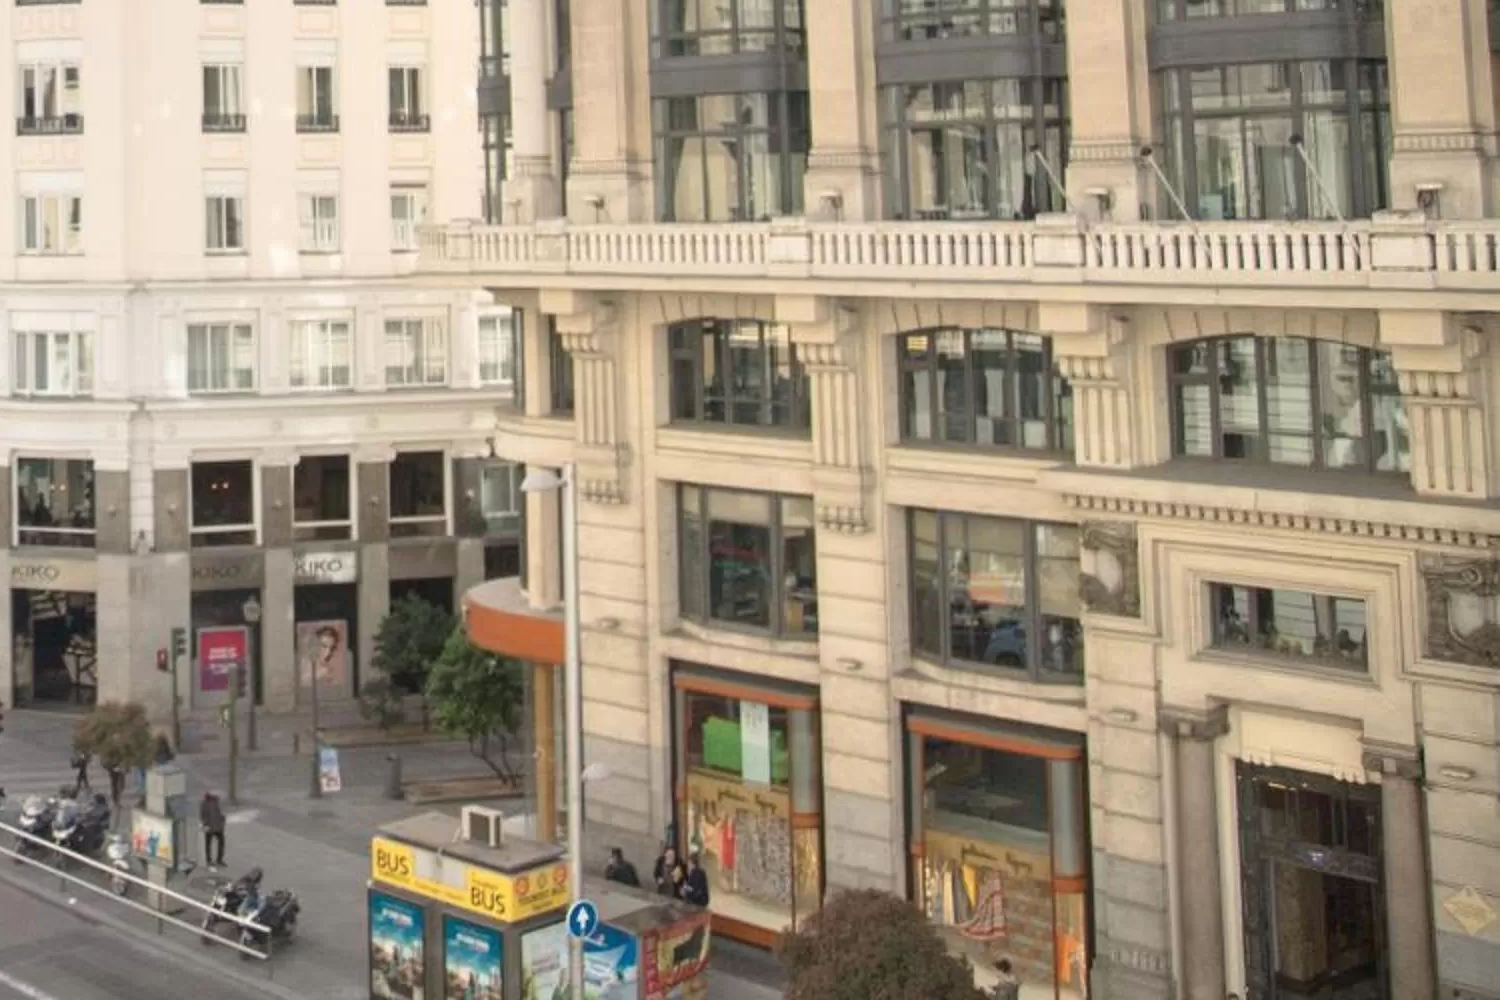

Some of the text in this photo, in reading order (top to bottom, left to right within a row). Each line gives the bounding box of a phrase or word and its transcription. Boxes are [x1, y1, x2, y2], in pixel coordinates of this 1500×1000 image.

[11, 563, 60, 582] KIKO
[192, 564, 241, 580] KIKO
[295, 558, 343, 576] KIKO
[376, 847, 411, 875] BUS
[470, 885, 506, 915] BUS
